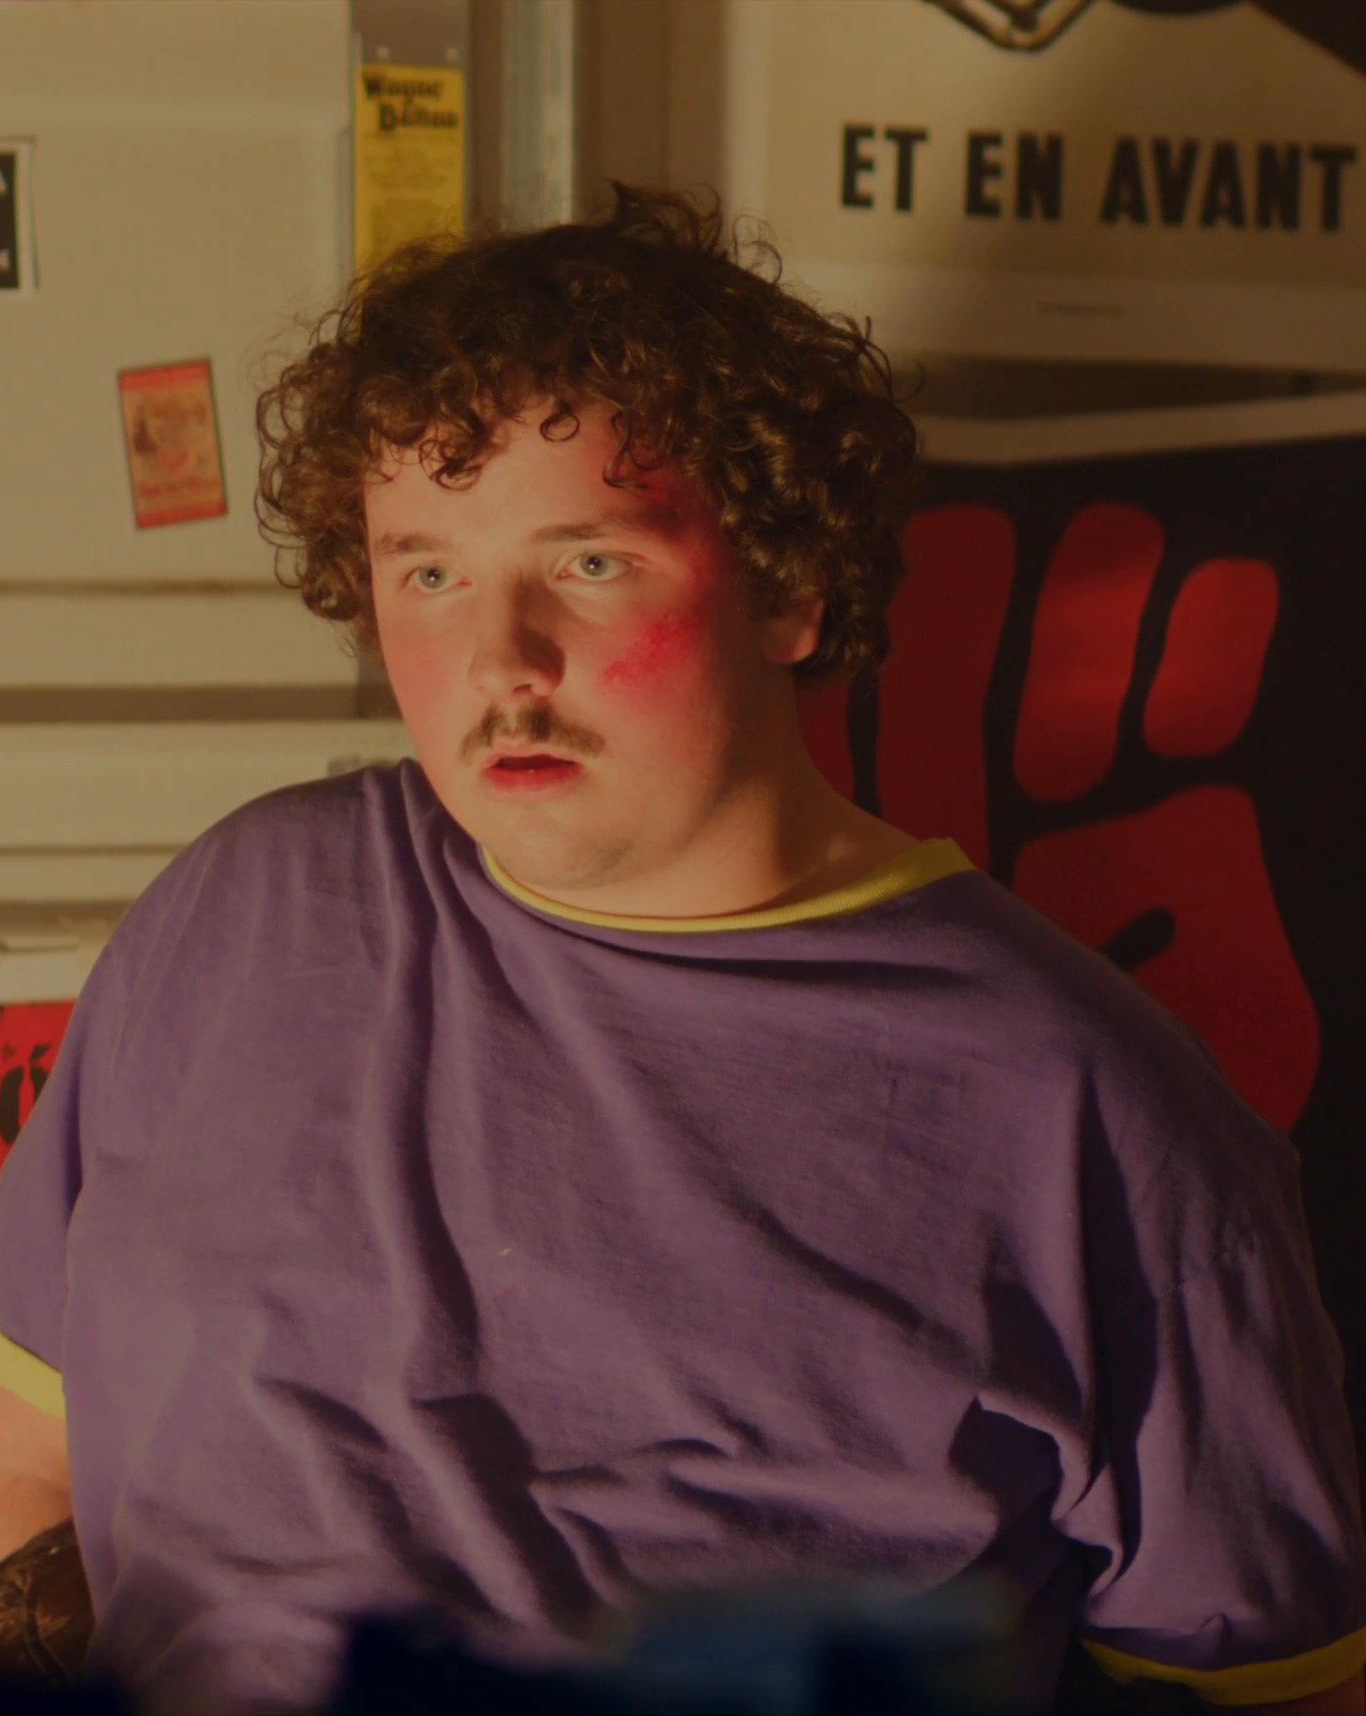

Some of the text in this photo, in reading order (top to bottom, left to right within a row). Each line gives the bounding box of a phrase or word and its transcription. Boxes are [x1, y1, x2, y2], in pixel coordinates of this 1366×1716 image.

[841, 123, 1357, 233] ET EN AVANT
